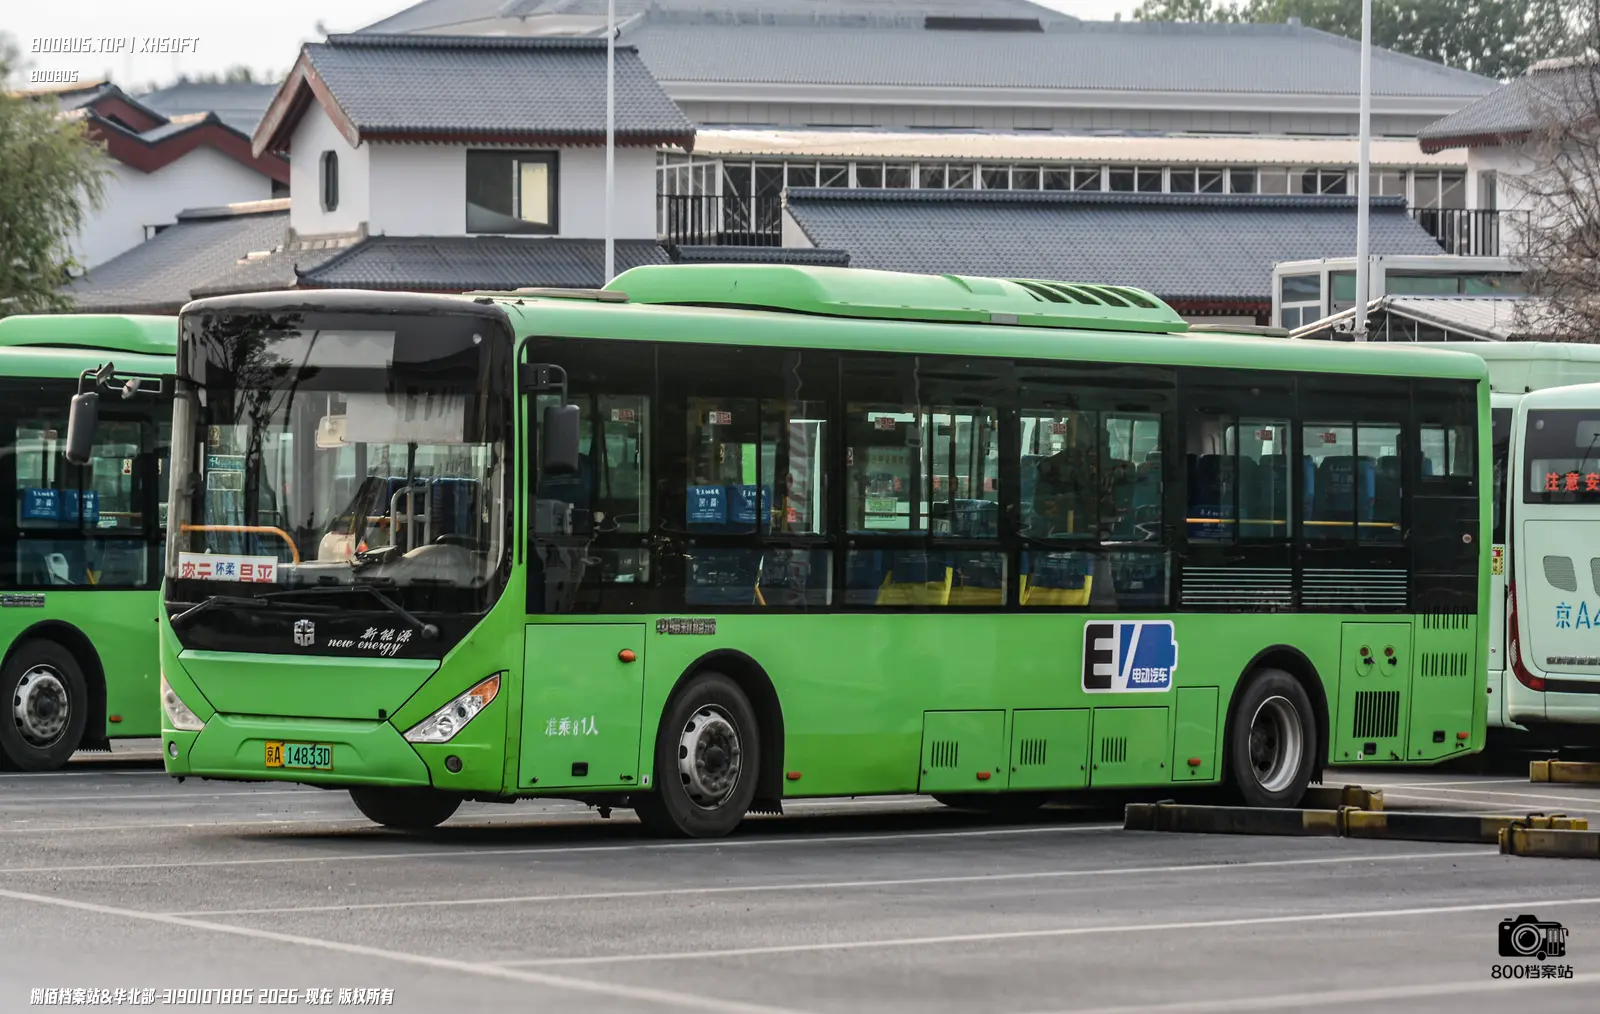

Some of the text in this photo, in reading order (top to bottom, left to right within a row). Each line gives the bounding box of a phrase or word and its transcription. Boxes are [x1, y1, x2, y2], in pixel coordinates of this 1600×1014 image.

[361, 627, 413, 642] 新能源
[327, 637, 402, 656] new energy
[1132, 667, 1168, 683] 电动汽车
